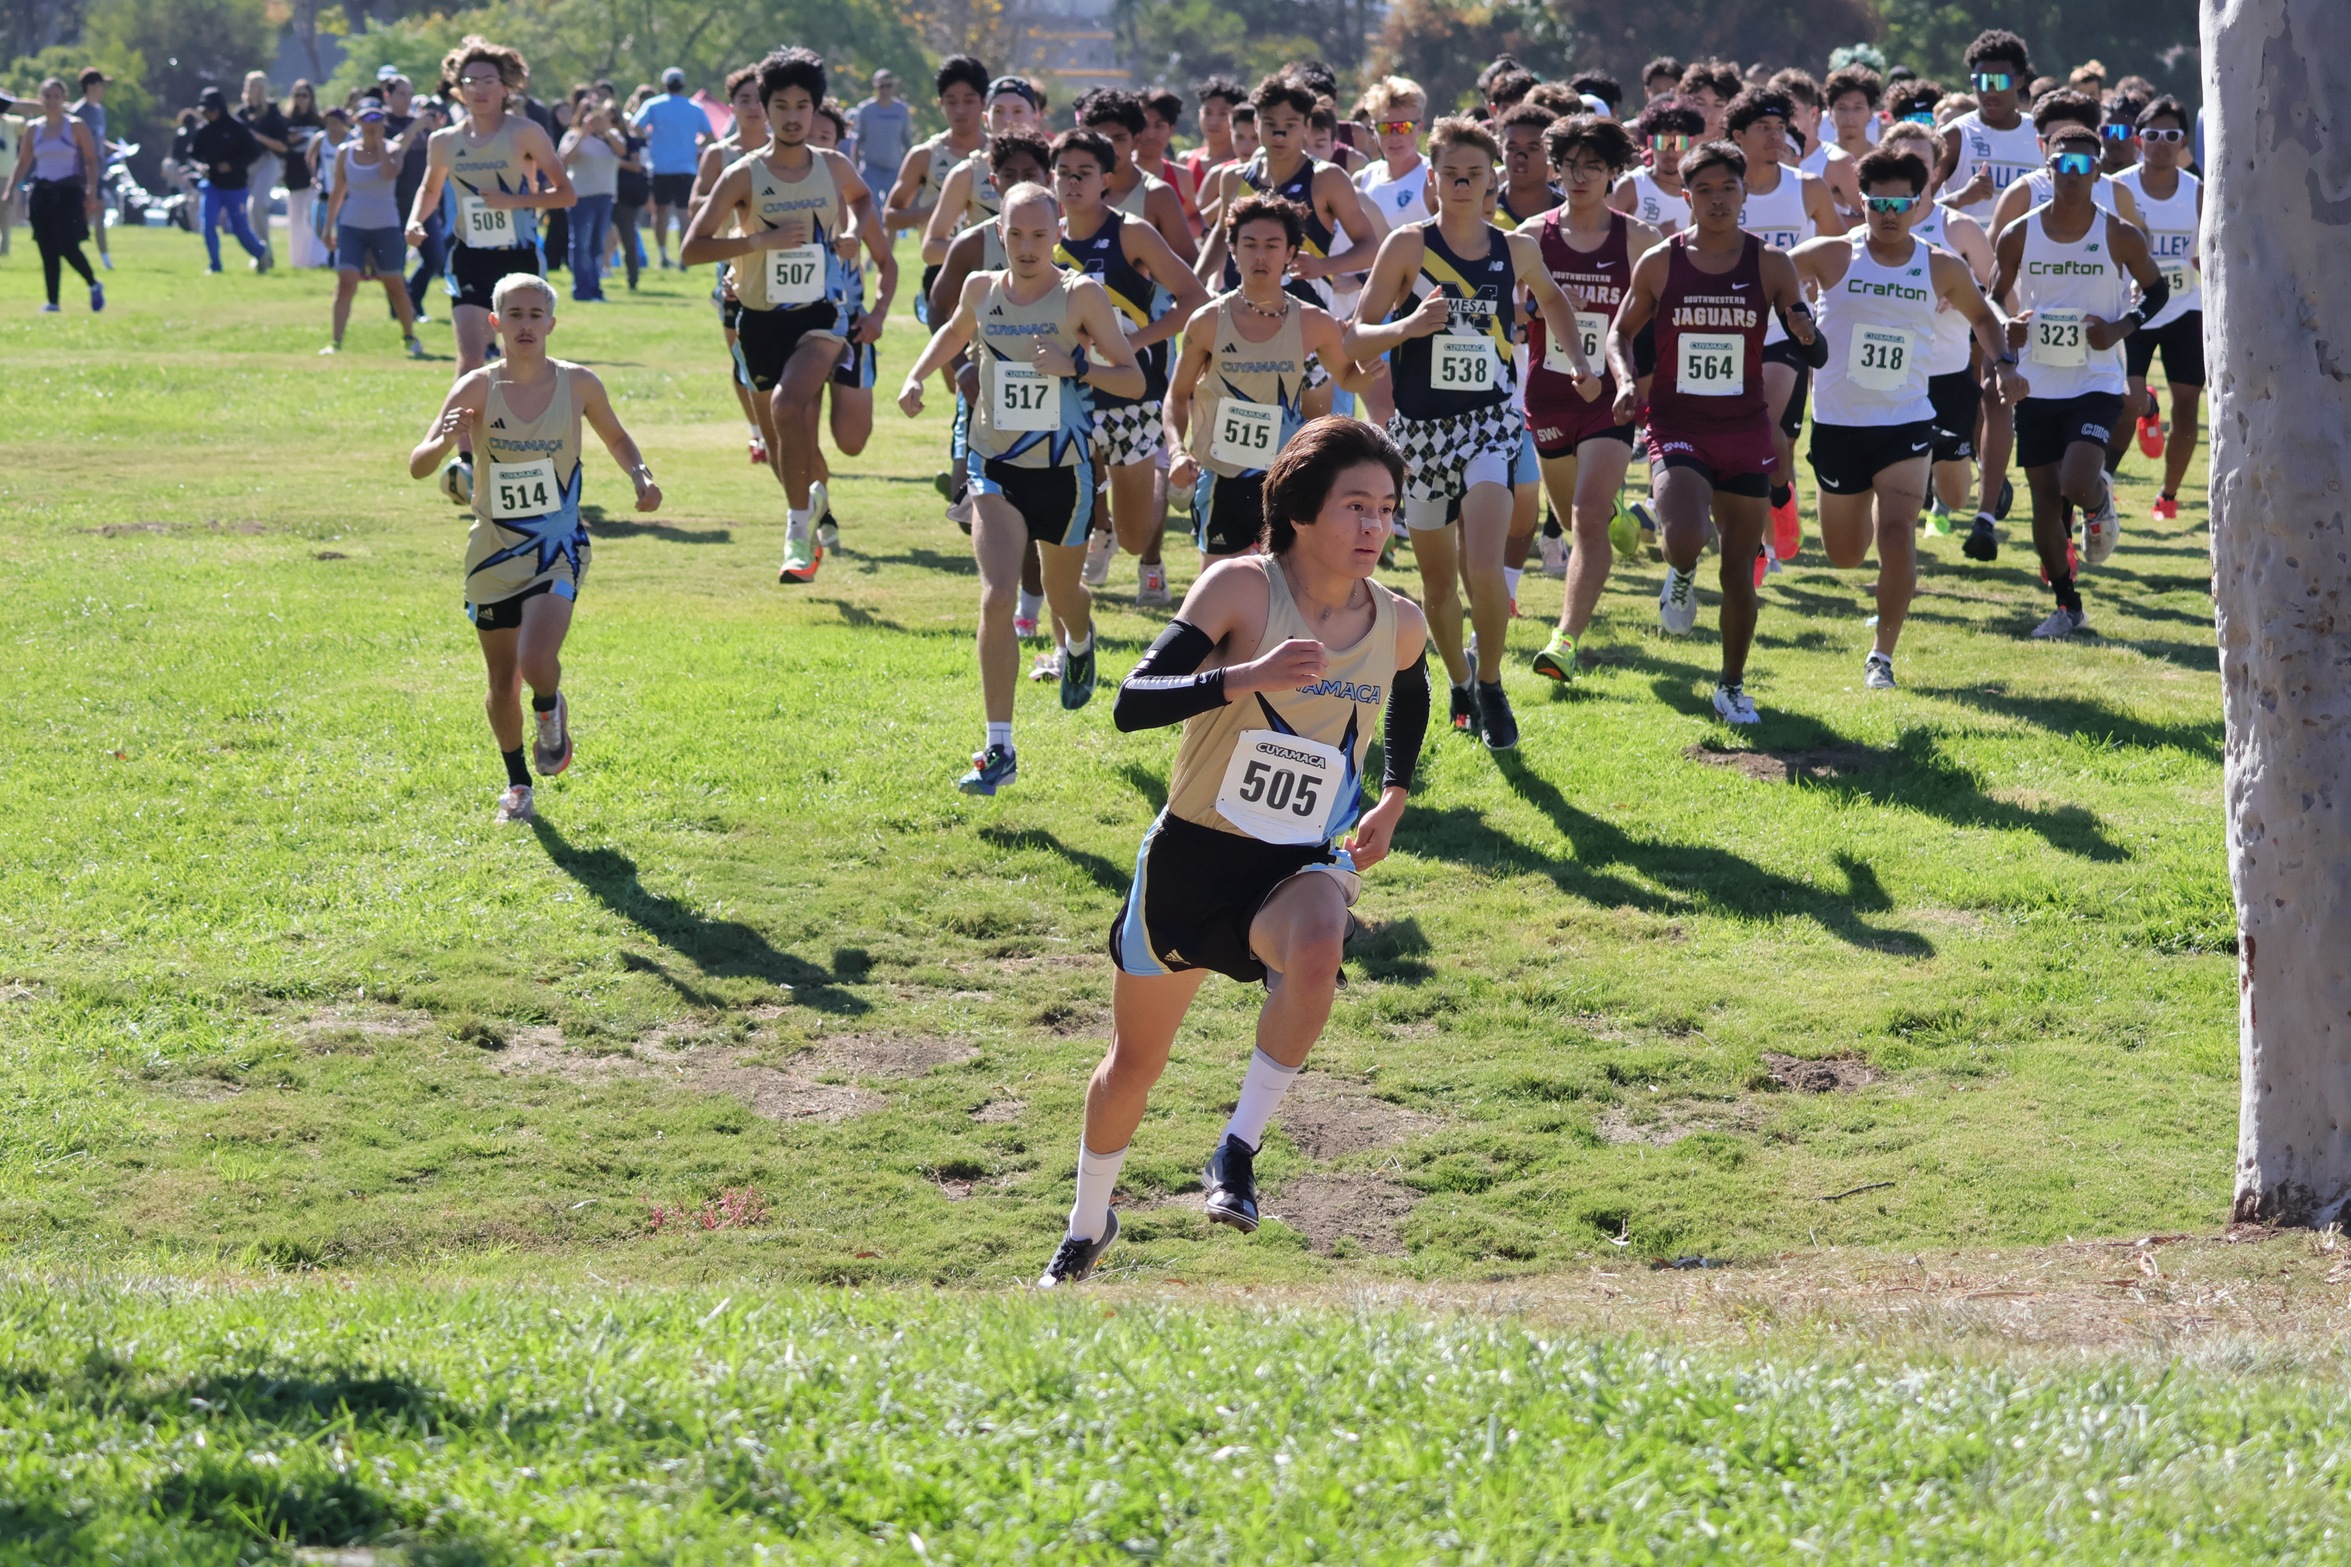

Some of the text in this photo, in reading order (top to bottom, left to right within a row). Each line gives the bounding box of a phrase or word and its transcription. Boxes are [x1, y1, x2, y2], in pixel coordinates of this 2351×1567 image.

[472, 211, 506, 231] 508
[2151, 234, 2191, 256] LLEY
[776, 263, 816, 285] 507
[2029, 261, 2104, 276] Crafton
[1683, 296, 1746, 305] SOUTHWESTERN
[1848, 278, 1928, 303] Crafton
[1449, 299, 1488, 313] MESA
[1672, 307, 1757, 328] JAGUARS
[985, 322, 1059, 337] CUYAMACA
[2040, 323, 2079, 347] 323
[1444, 343, 1486, 352] CUYAMACA
[1689, 342, 1733, 350] CUYAMACA
[1861, 343, 1903, 370] 318
[1221, 360, 1295, 373] CUYAMACA
[1442, 356, 1486, 383] 538
[1688, 355, 1733, 380] 564
[1004, 383, 1048, 410] 517
[1224, 418, 1270, 449] 515
[499, 468, 543, 480] CUYAMACA
[500, 482, 548, 510] 514
[1296, 679, 1381, 705] AMACA
[1255, 742, 1326, 769] CUYAMACA
[1239, 760, 1323, 816] 505
